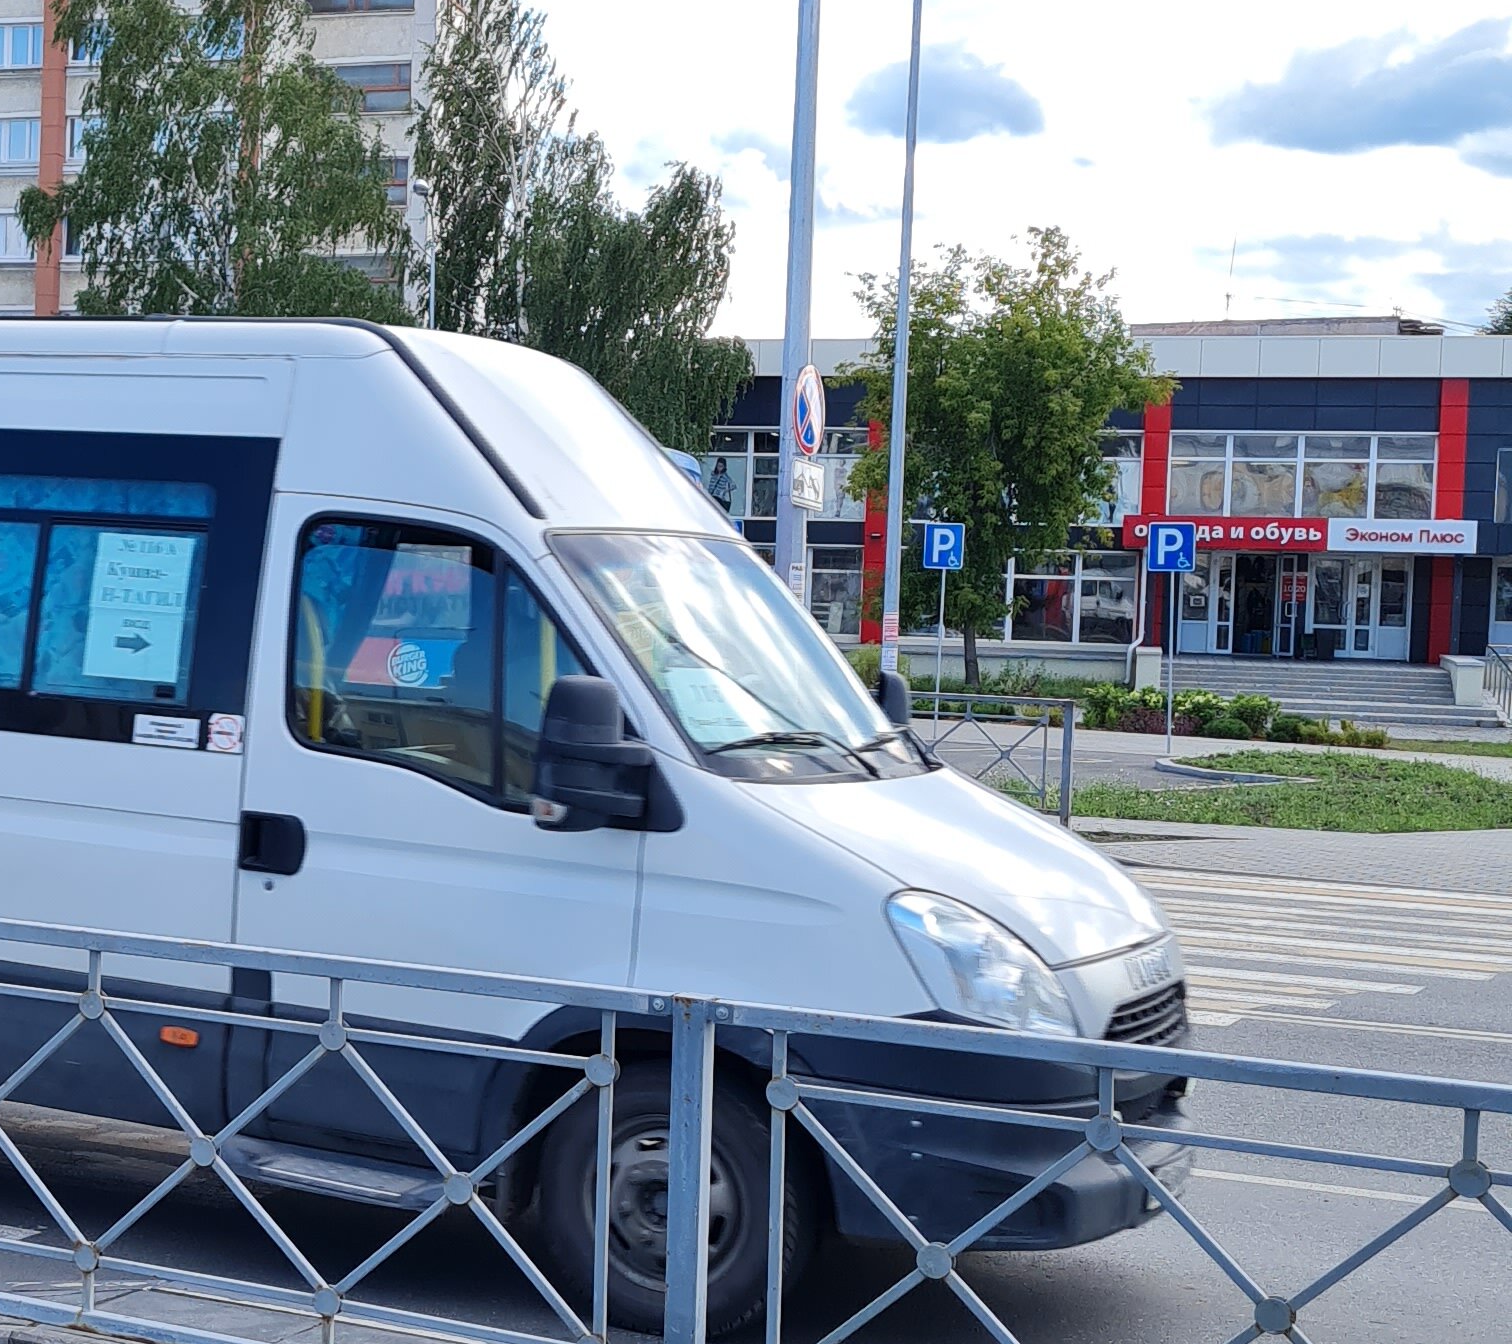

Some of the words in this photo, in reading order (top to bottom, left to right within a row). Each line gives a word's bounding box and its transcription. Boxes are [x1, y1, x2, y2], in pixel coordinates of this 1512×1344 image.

[1134, 524, 1224, 542] ода
[1230, 526, 1244, 539] и
[1251, 522, 1322, 544] обувь
[1345, 527, 1413, 543] Эконом
[1419, 529, 1465, 544] Плюс
[932, 528, 955, 563] P
[1157, 528, 1184, 565] P
[391, 650, 426, 664] BURGER
[392, 659, 427, 676] KING
